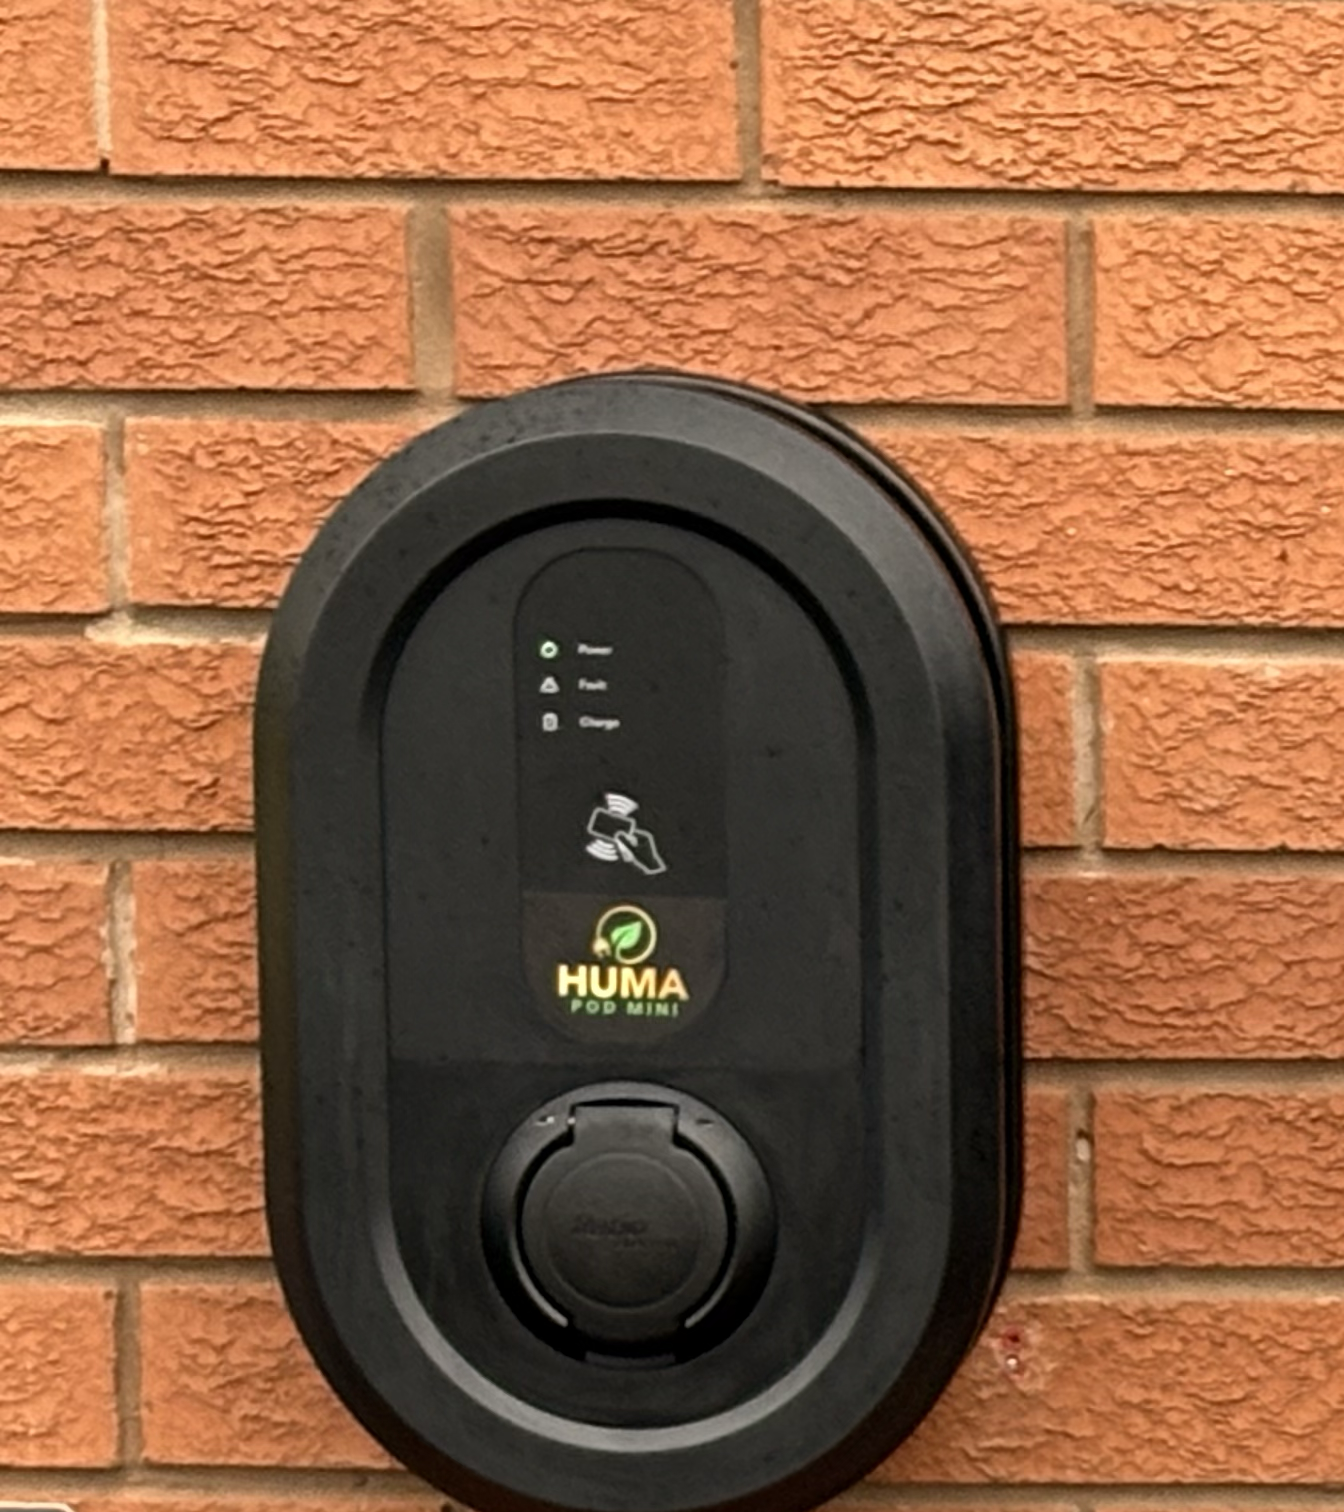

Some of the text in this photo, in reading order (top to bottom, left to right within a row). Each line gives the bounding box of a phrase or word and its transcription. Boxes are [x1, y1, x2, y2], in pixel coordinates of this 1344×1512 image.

[557, 964, 690, 1001] HUMA
[570, 999, 679, 1018] POD MINI
